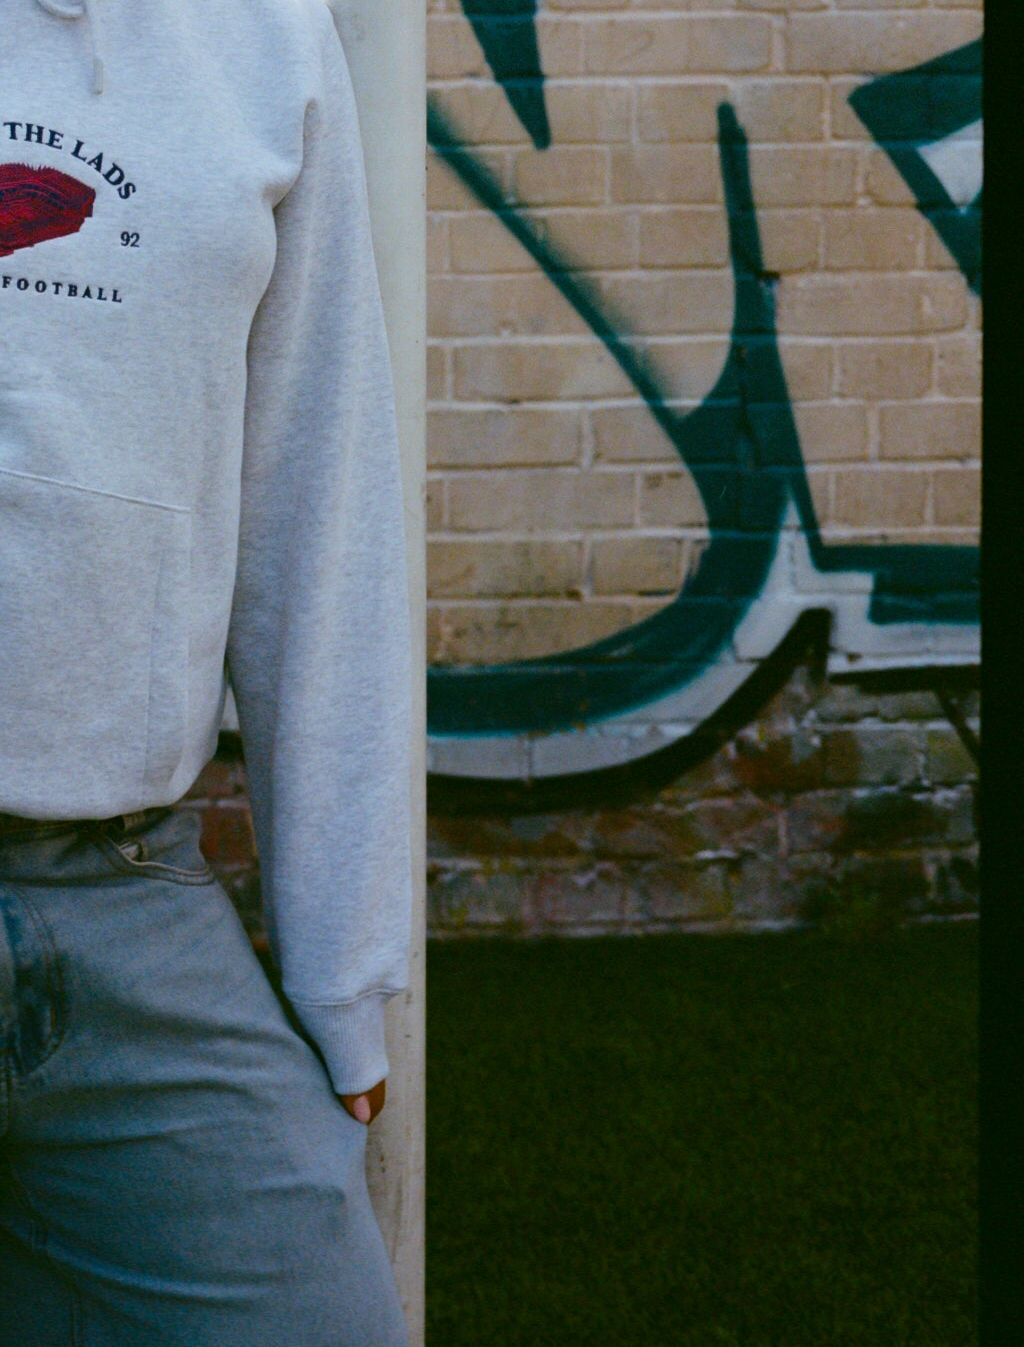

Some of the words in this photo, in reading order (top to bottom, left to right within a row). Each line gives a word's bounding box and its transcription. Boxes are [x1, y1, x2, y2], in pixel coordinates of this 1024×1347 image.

[4, 122, 63, 149] THE
[72, 140, 136, 199] LADS
[121, 232, 139, 247] 92
[3, 276, 121, 302] FOOTBALL
